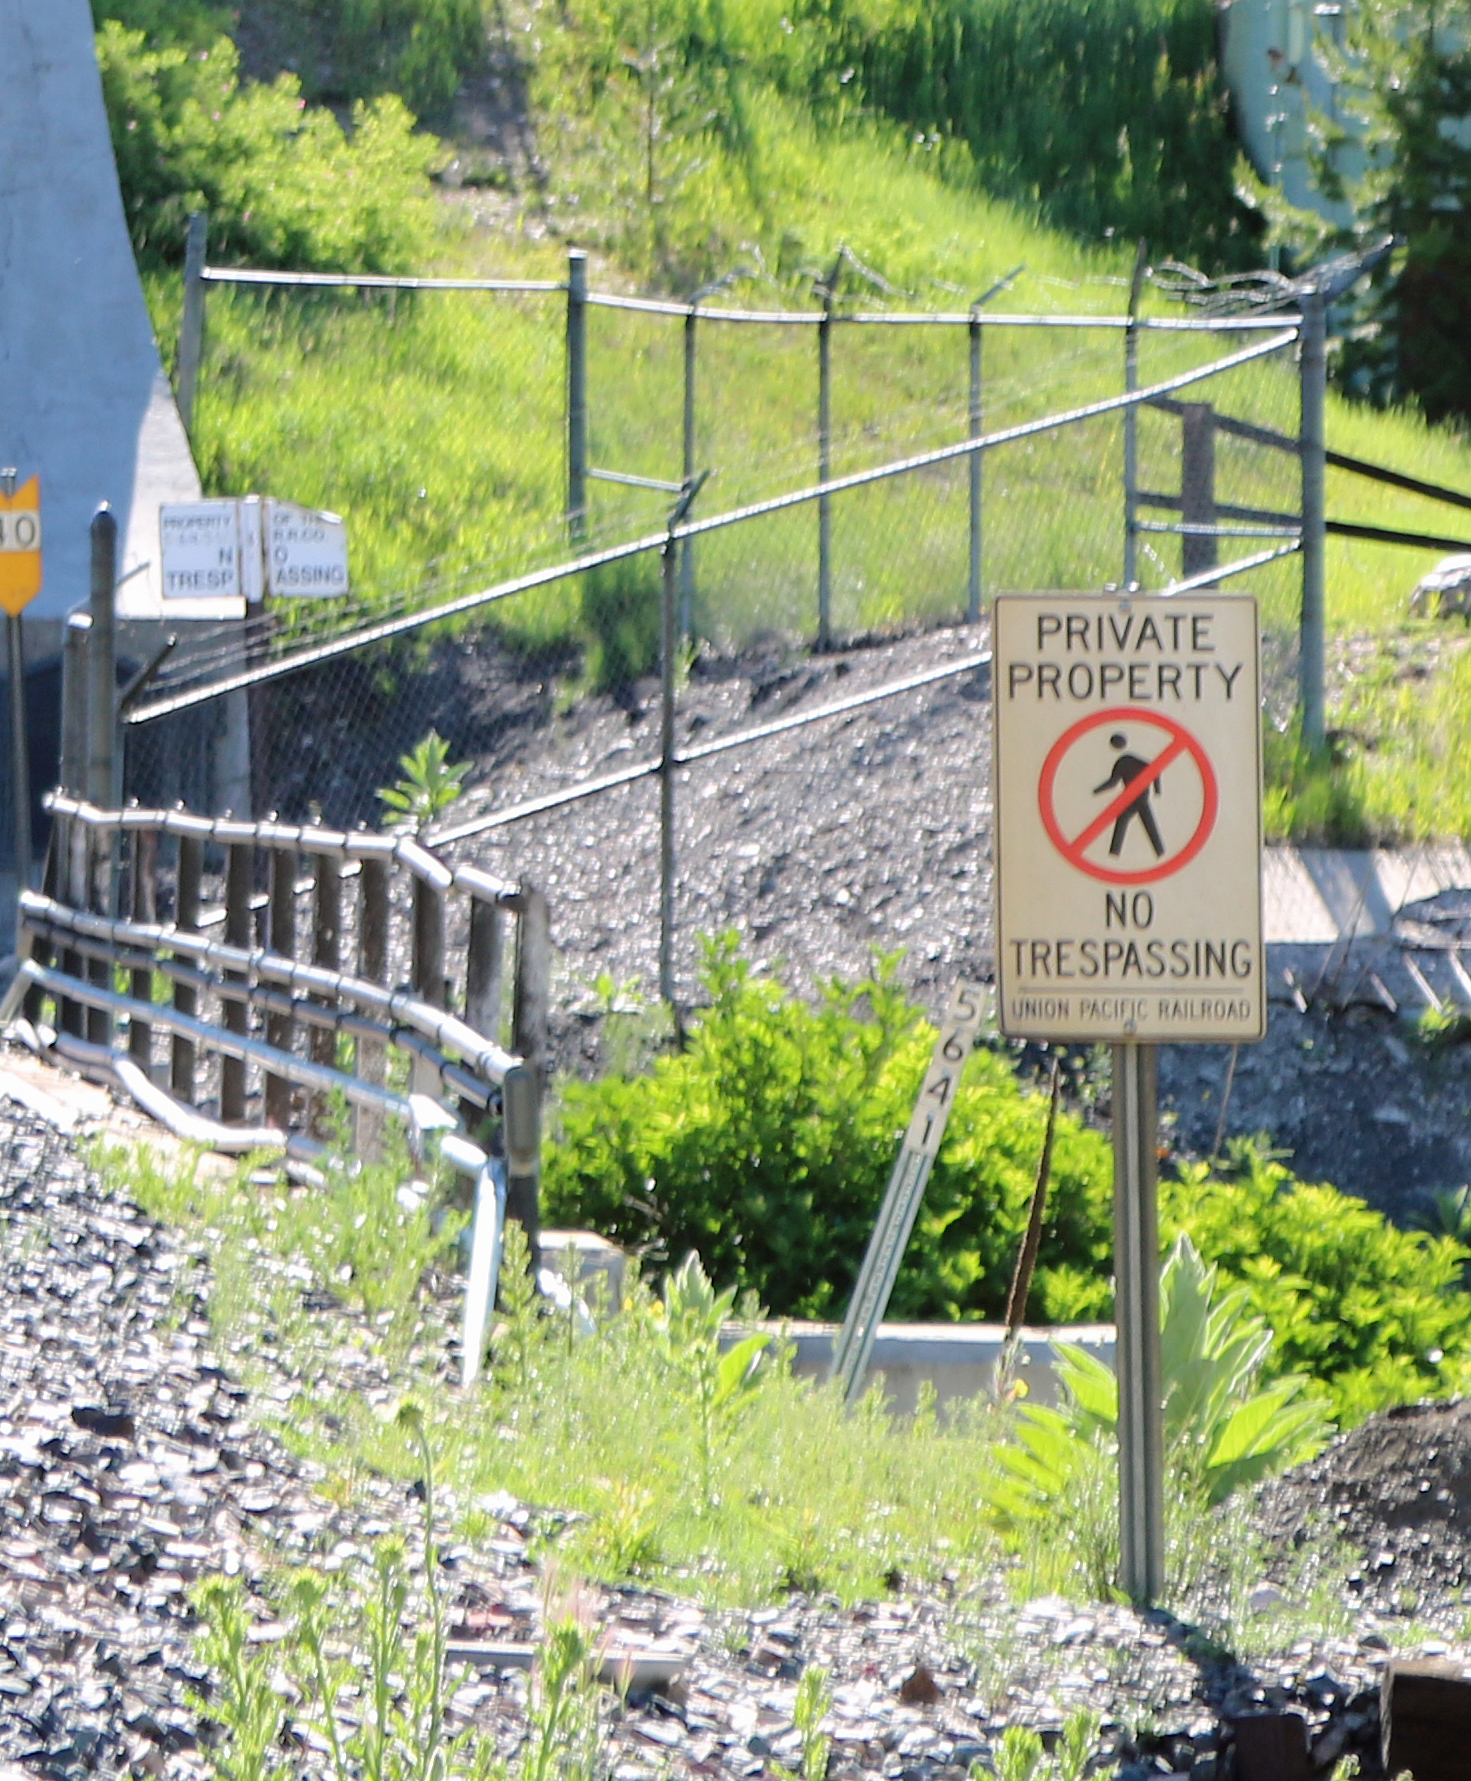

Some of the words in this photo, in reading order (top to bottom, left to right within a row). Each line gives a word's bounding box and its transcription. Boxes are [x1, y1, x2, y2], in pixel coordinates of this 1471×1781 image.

[1036, 612, 1216, 653] PRIVATE
[1008, 662, 1244, 702] PROPERTY
[1104, 891, 1154, 930] NO
[1010, 939, 1252, 979] TRESPASSING
[1011, 998, 1070, 1022] UNION
[1079, 998, 1149, 1022] PACIFIC
[1158, 998, 1252, 1022] RAILROAD
